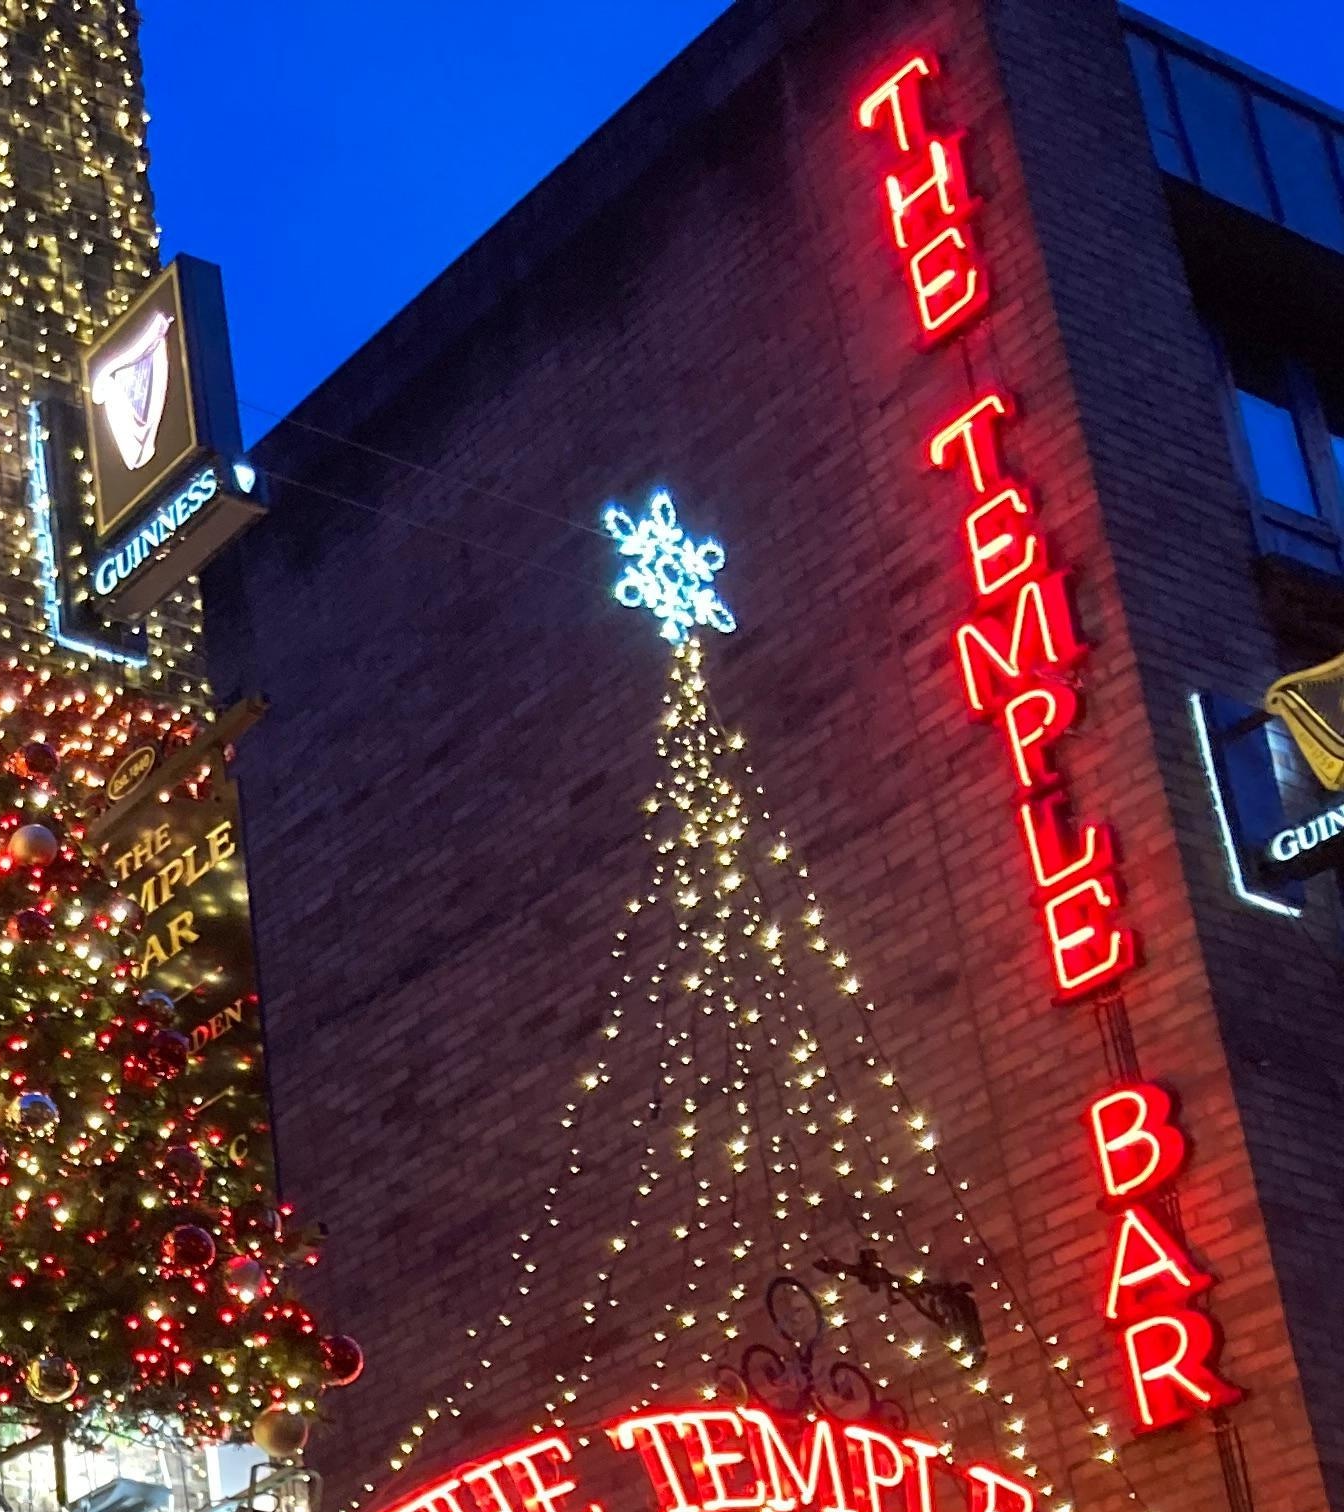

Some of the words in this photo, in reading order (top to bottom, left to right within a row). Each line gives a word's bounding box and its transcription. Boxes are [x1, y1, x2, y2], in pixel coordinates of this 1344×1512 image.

[95, 469, 218, 597] GUINNESS
[857, 55, 980, 335] THE
[930, 395, 1124, 992] TEMPLE
[1091, 1088, 1217, 1428] BAR
[114, 823, 171, 881] THE
[127, 821, 237, 917] MPLE
[132, 911, 200, 979] AR
[189, 999, 244, 1053] DEN
